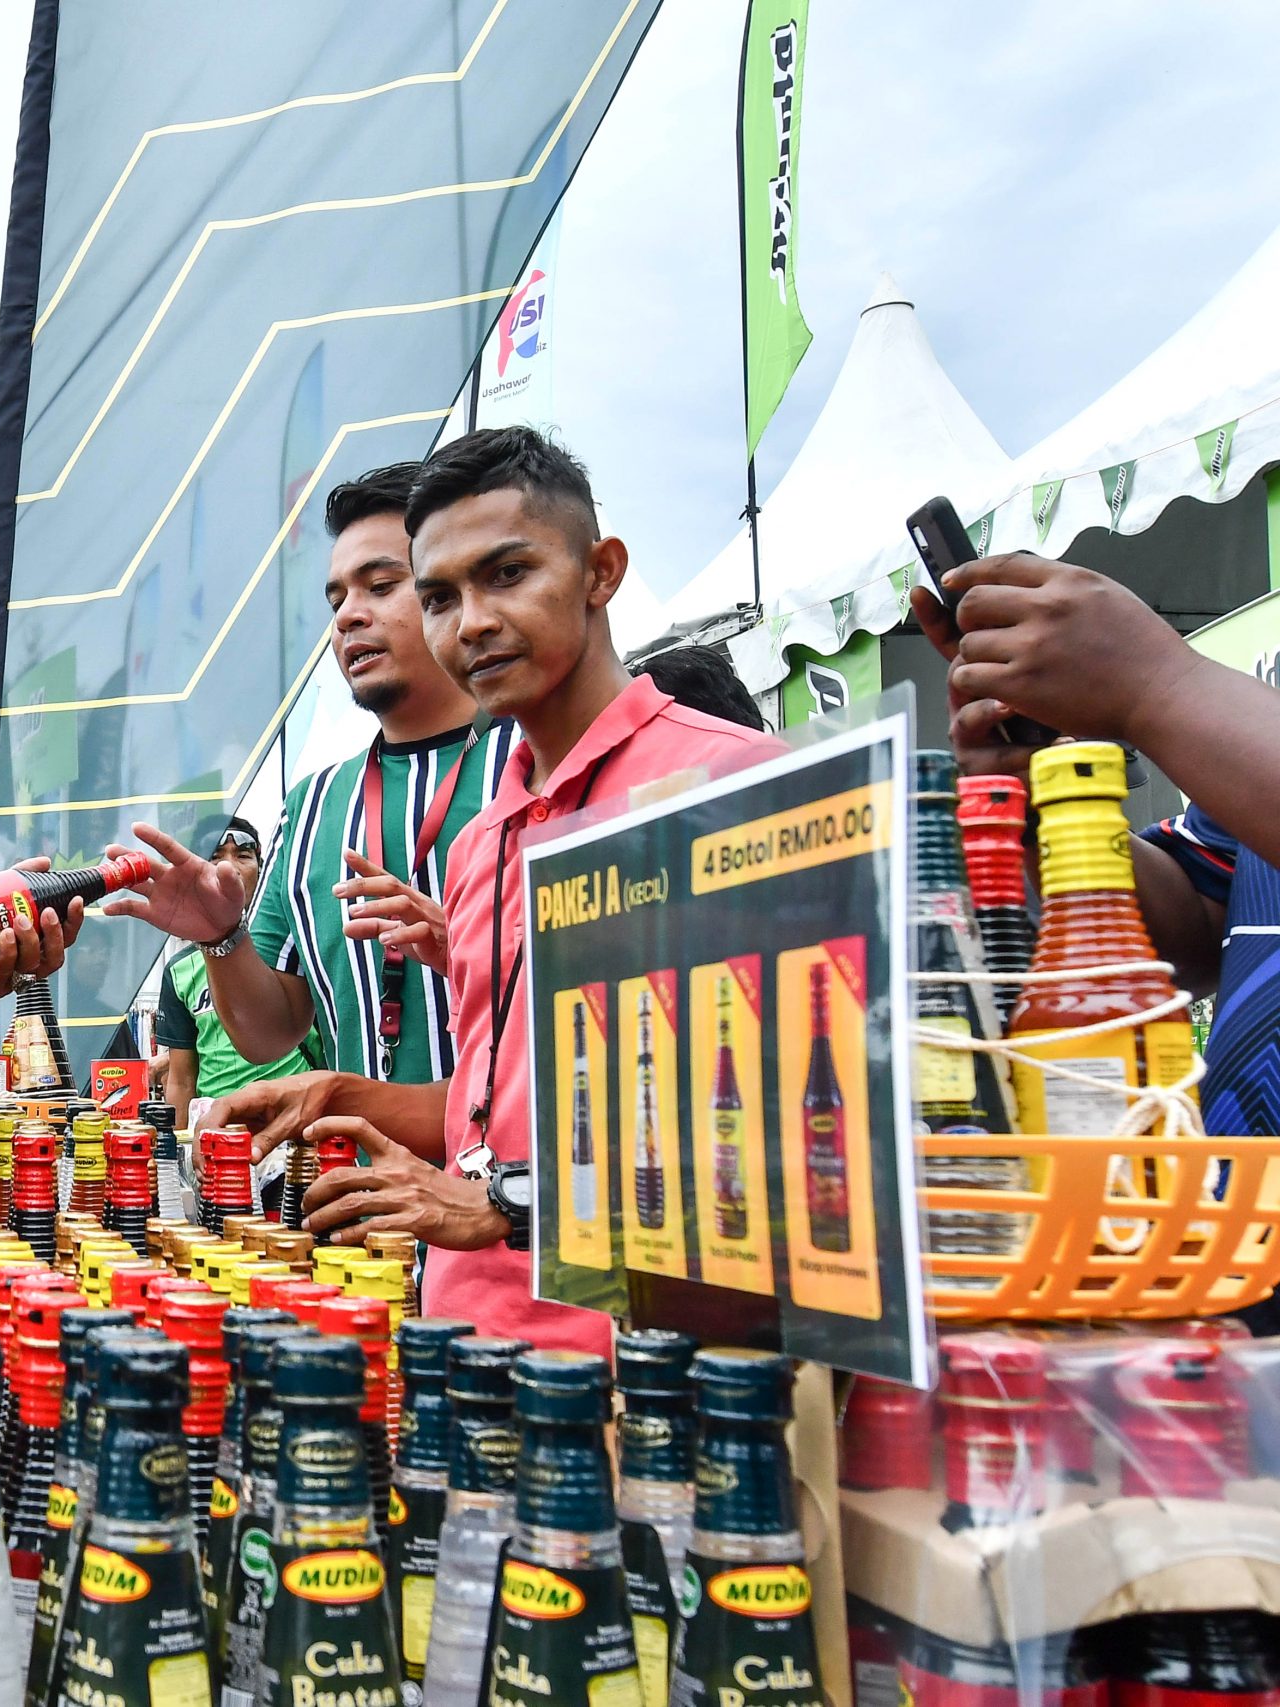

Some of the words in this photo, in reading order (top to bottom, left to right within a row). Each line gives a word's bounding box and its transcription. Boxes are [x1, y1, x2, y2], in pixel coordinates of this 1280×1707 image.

[703, 852, 715, 877] 4
[719, 830, 773, 875] Botol
[777, 803, 876, 859] RM10.00
[536, 869, 602, 933] PAKEJ
[605, 863, 621, 916] A
[622, 866, 669, 914] (KECIL)
[299, 1566, 379, 1588] MUDIM
[305, 1640, 385, 1678] Cuka
[493, 1644, 552, 1695] Cuka
[732, 1654, 814, 1691] Cuka
